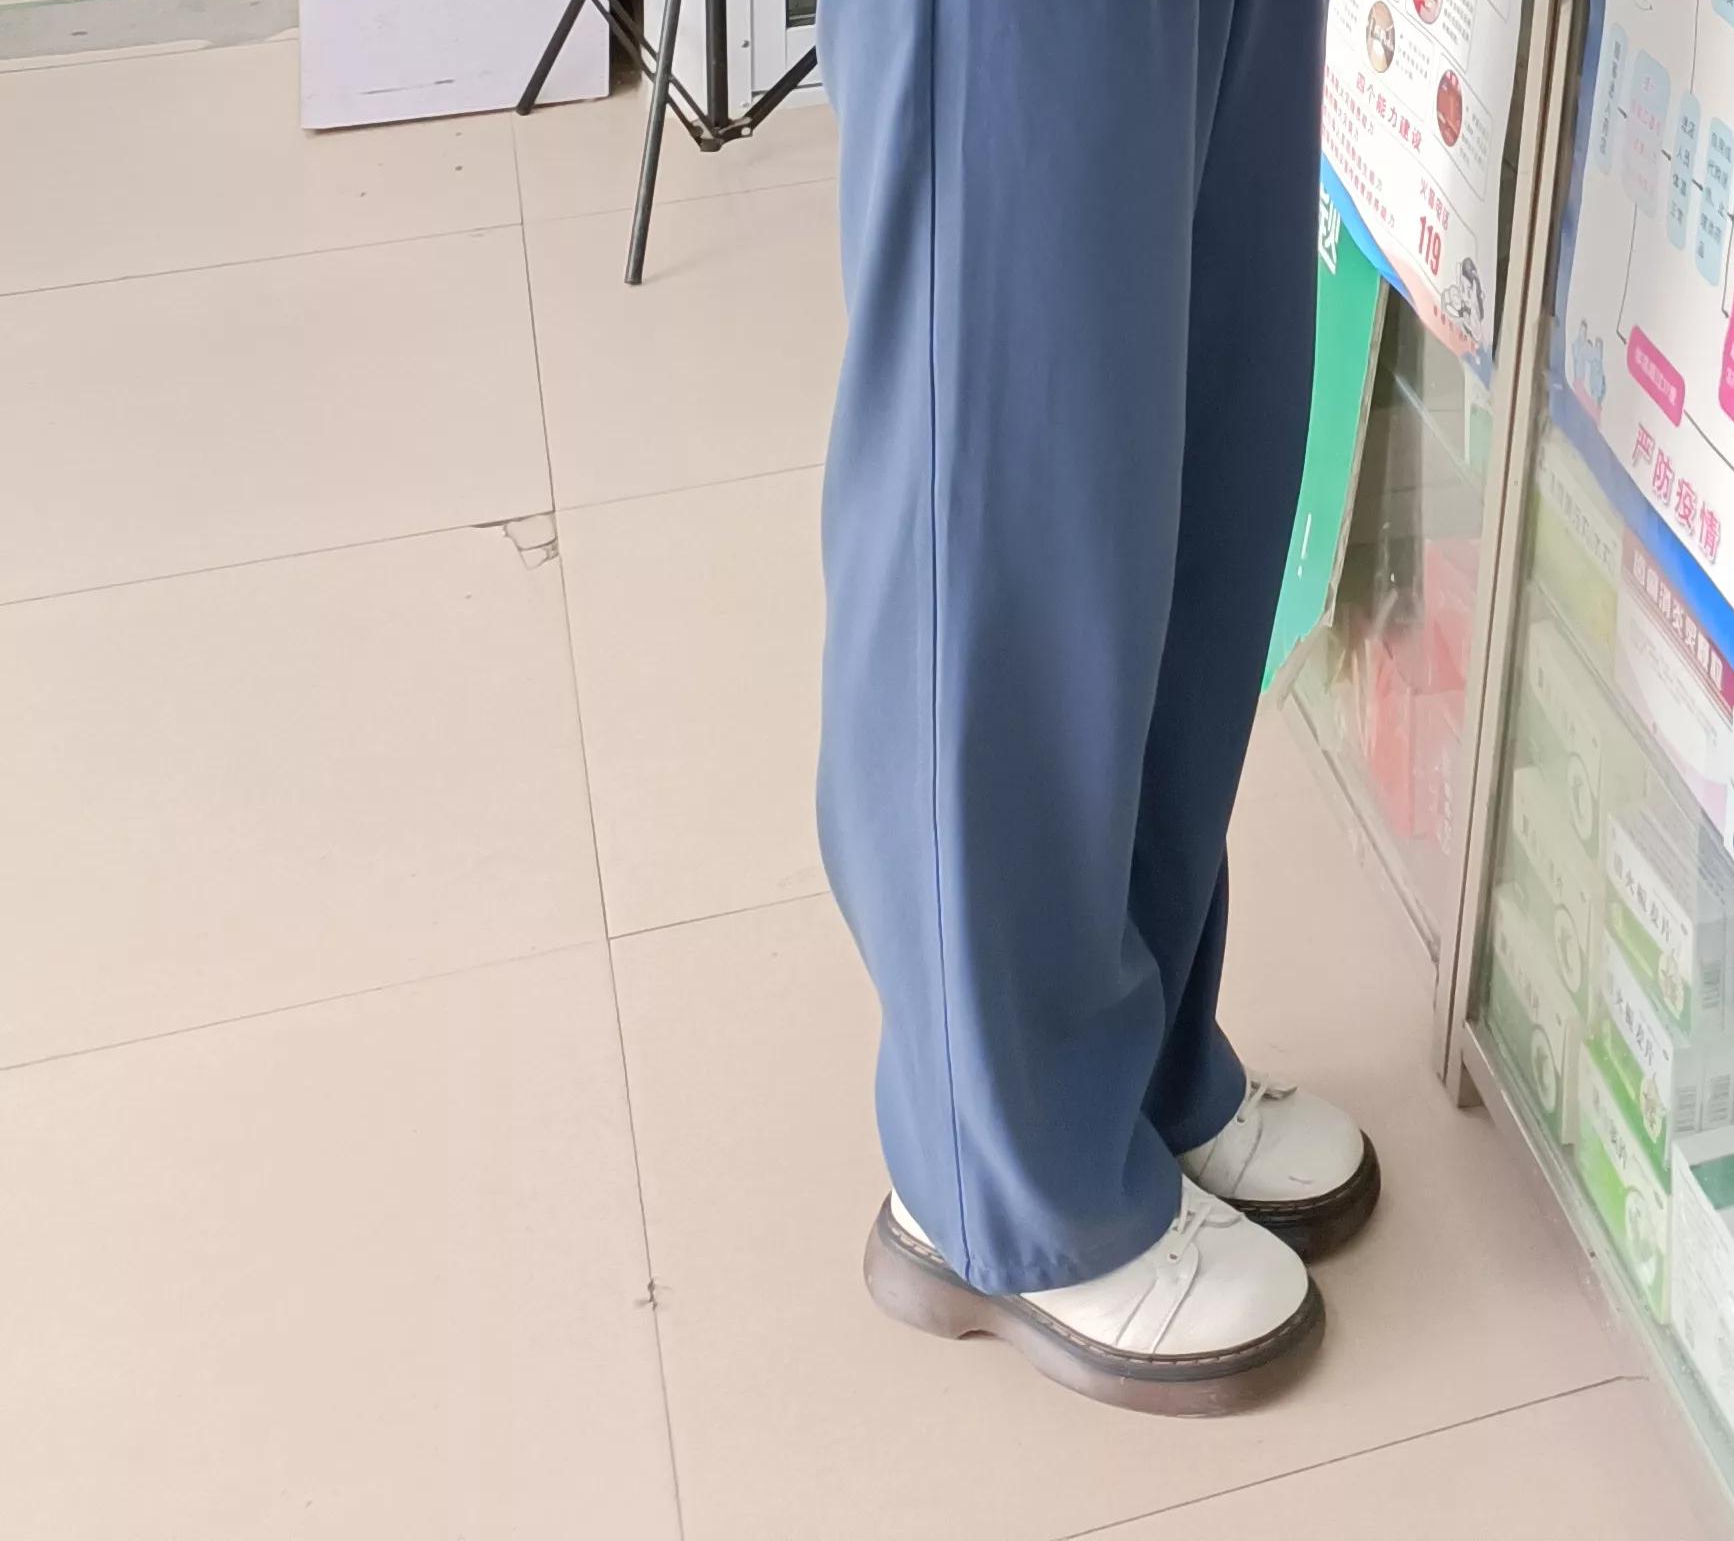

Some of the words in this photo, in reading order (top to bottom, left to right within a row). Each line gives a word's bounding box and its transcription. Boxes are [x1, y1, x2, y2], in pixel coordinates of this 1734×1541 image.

[1354, 69, 1423, 153] 四个能力建设
[1417, 213, 1443, 278] 119
[1630, 420, 1722, 567] 严防疫情
